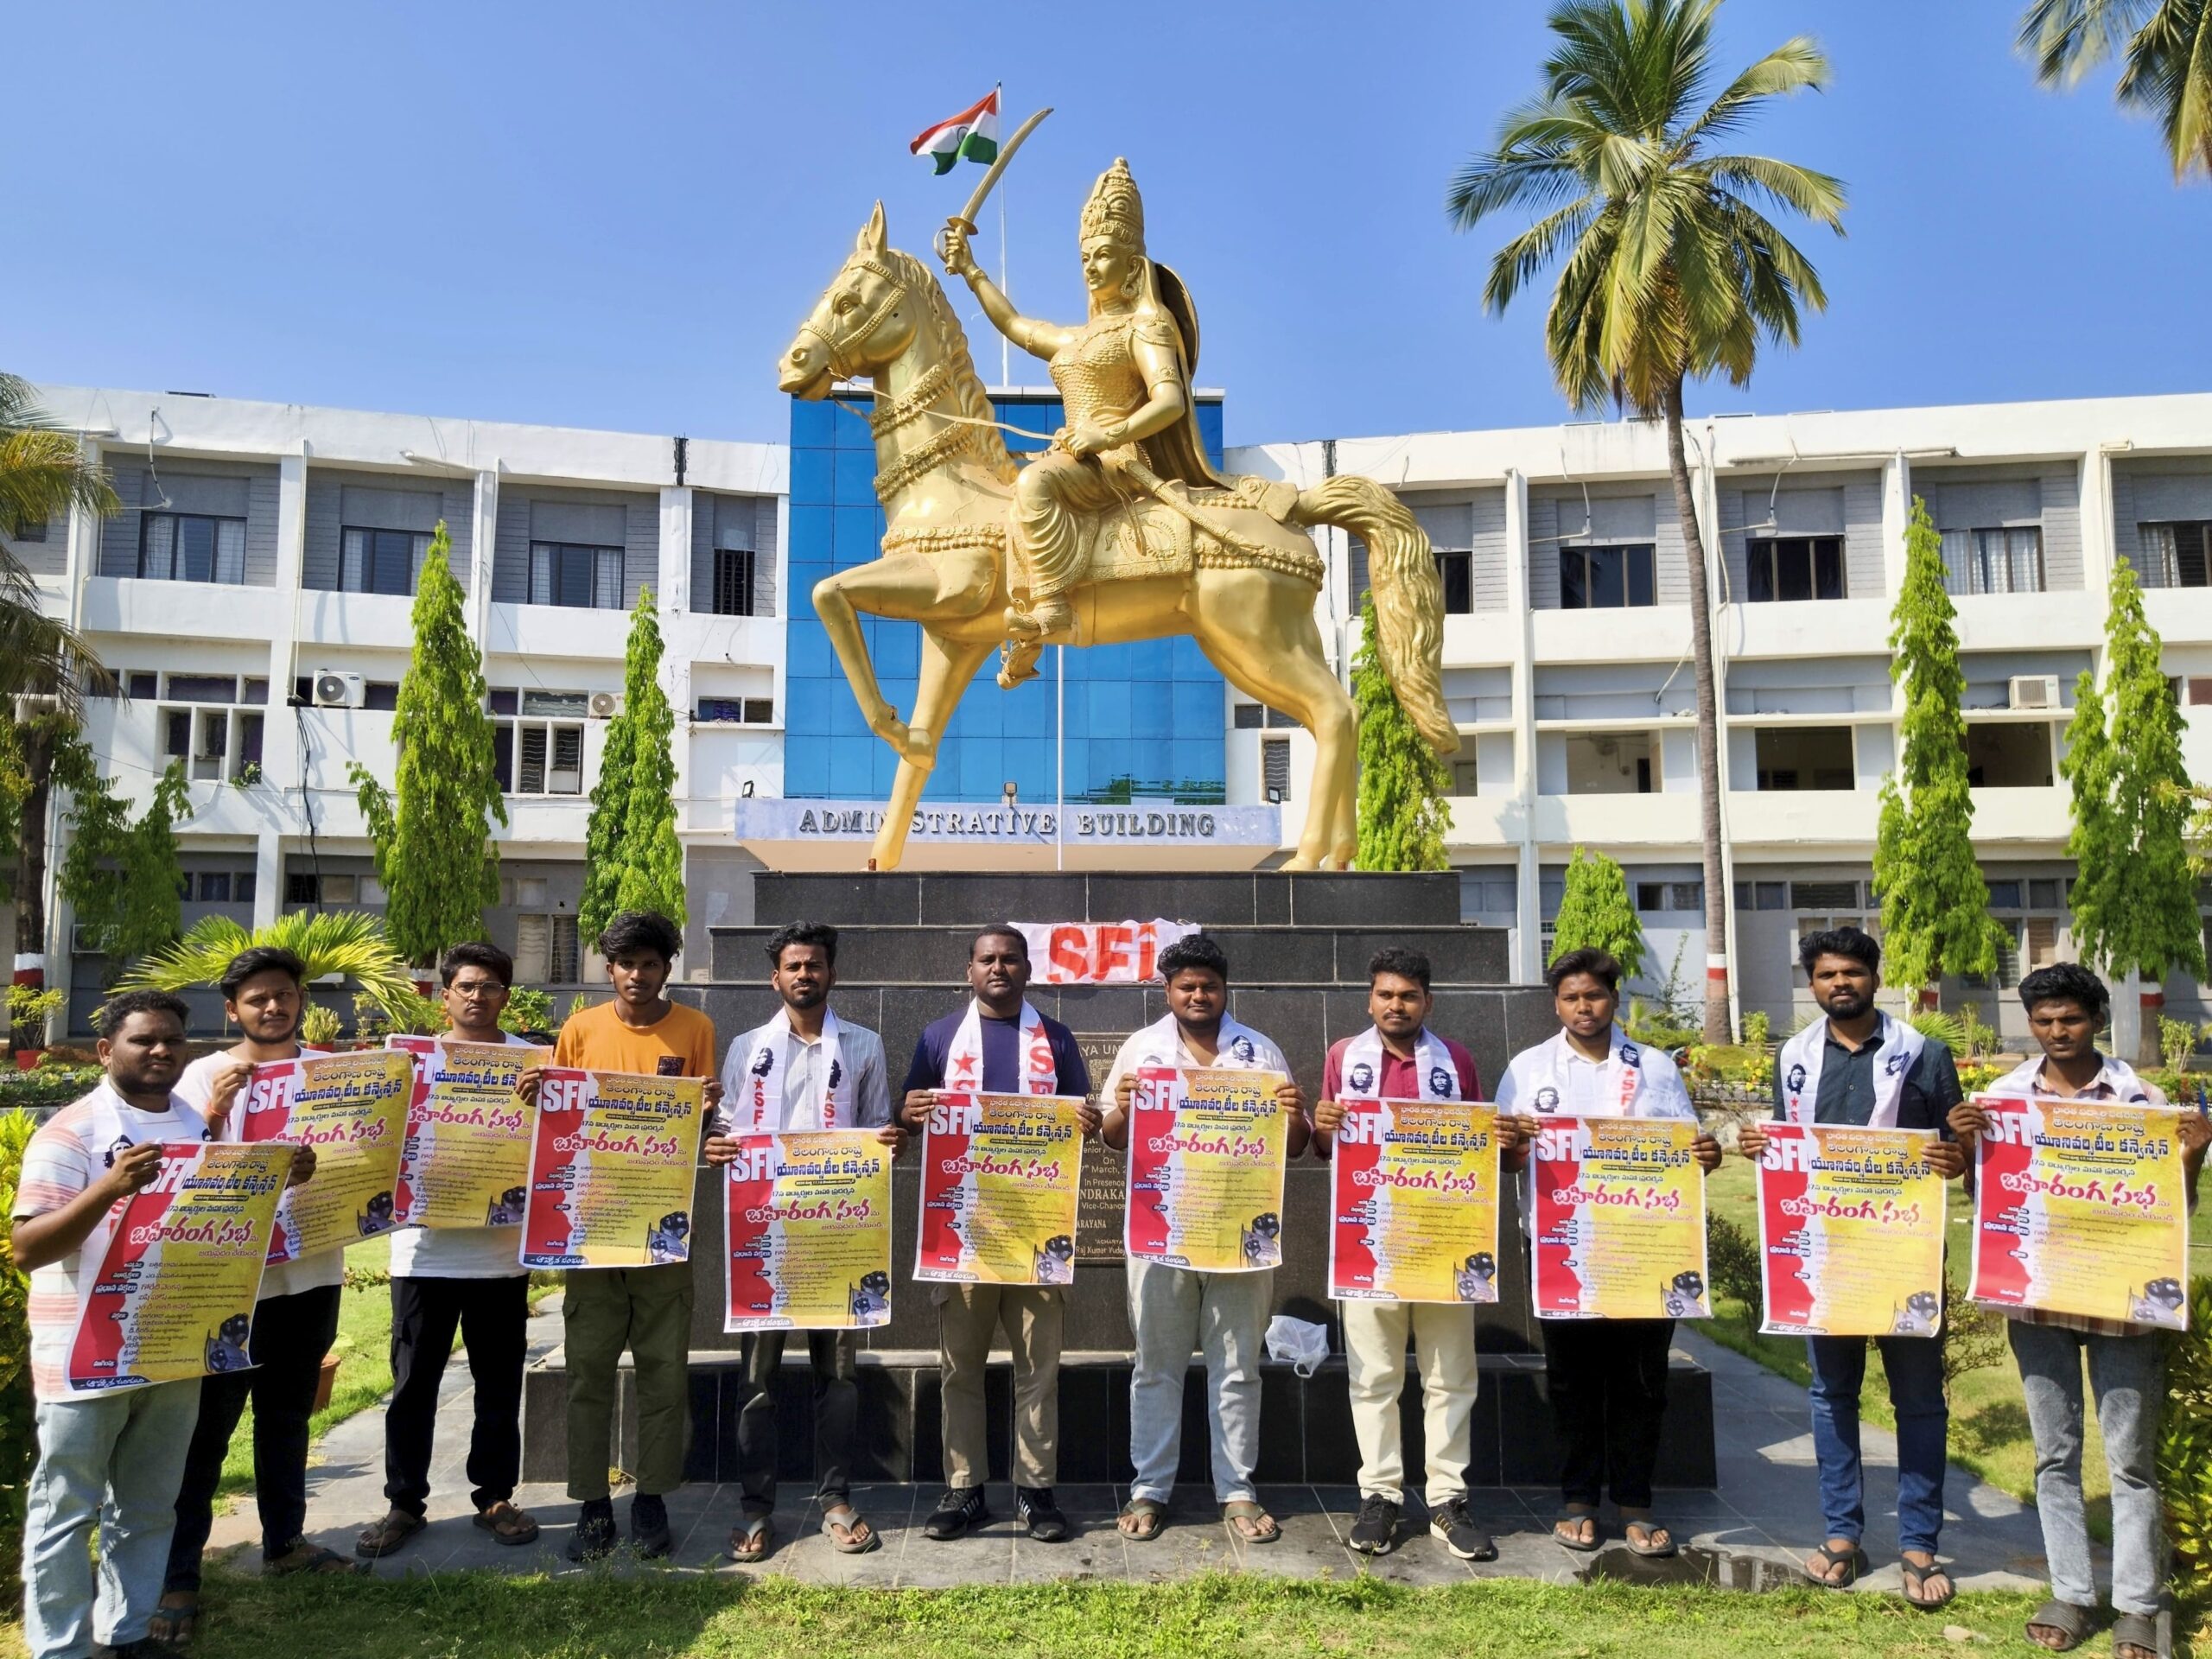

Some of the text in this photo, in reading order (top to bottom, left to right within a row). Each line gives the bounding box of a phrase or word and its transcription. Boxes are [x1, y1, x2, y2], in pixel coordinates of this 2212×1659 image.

[800, 809, 1215, 836] ADMISTRATIVE BUILDING
[1046, 923, 1158, 982] SFI
[453, 1057, 500, 1066] తెలంగాణ
[313, 1069, 362, 1081] తెలంగాణ
[1194, 1084, 1238, 1092] తెలంగాణ
[249, 1076, 294, 1115] SFI
[543, 1078, 587, 1113] SFI
[605, 1084, 652, 1094] తెలంగాణ
[1137, 1077, 1177, 1114] SFI
[931, 1103, 971, 1137] SFI
[988, 1109, 1033, 1117] తెలంగాణ
[1400, 1116, 1446, 1126] తెలంగాణ
[2053, 1118, 2113, 1130] తెలంగాణ
[553, 1129, 640, 1154] బహిరంగ
[1340, 1111, 1382, 1147] SFI
[1598, 1133, 1646, 1142] తెలంగాణ
[1980, 1109, 2031, 1150] SFI
[1148, 1130, 1230, 1155] బహిరంగ
[1536, 1128, 1580, 1164] SFI
[1762, 1137, 1808, 1174] SFI
[1827, 1143, 1879, 1154] తెలంగాణ
[207, 1160, 247, 1169] తెలంగాణ
[730, 1148, 774, 1182] SFI
[942, 1153, 1024, 1177] బహిరంగ
[1091, 1165, 1120, 1174] March,
[1103, 1156, 1116, 1165] On
[1353, 1164, 1439, 1190] బహిరంగ
[1999, 1168, 2105, 1201] బహిరంగ
[1552, 1181, 1640, 1207] బహిరంగ
[1782, 1192, 1877, 1221] బహిరంగ
[745, 1198, 832, 1224] బహిరంగ
[130, 1215, 216, 1244] బహిరంగ
